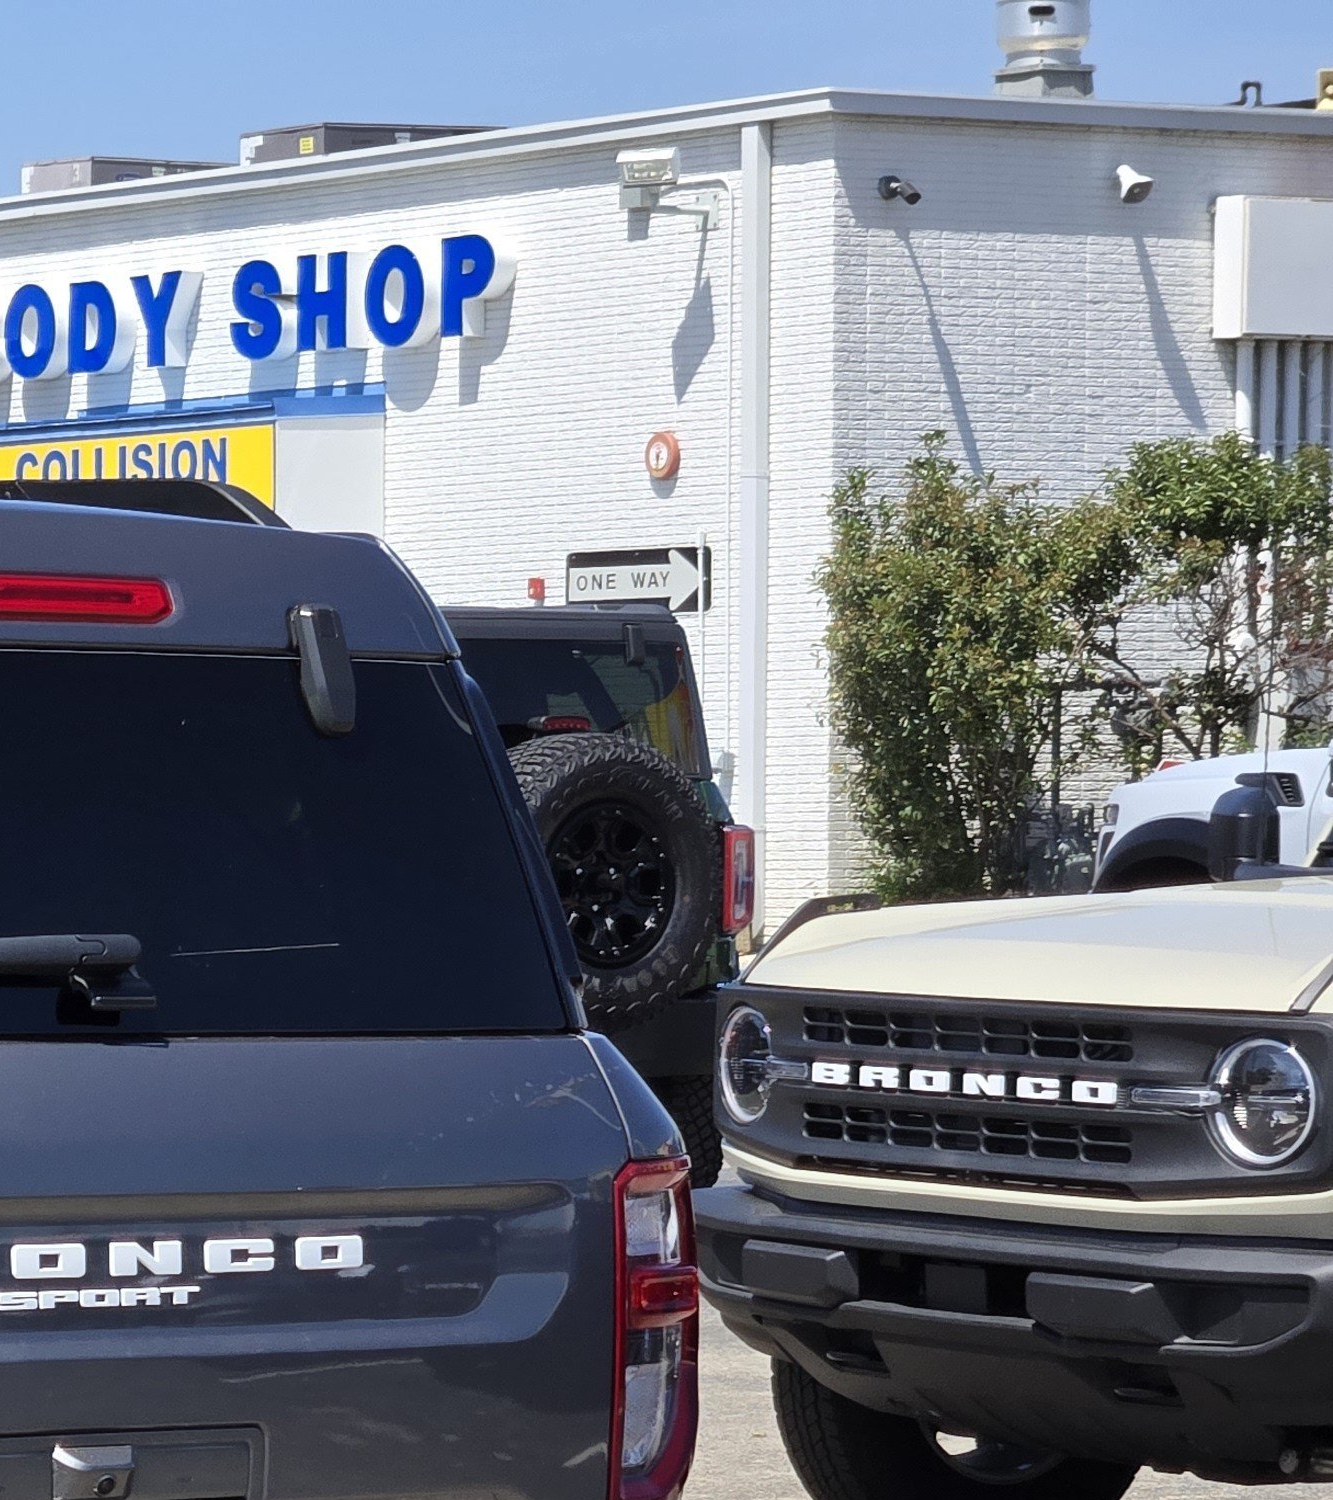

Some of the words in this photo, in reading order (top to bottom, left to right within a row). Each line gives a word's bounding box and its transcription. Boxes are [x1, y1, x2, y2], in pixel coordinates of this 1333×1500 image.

[229, 234, 496, 361] SHOP
[576, 573, 617, 592] ONE
[631, 571, 670, 589] WAY
[811, 1062, 1118, 1105] BRONCO
